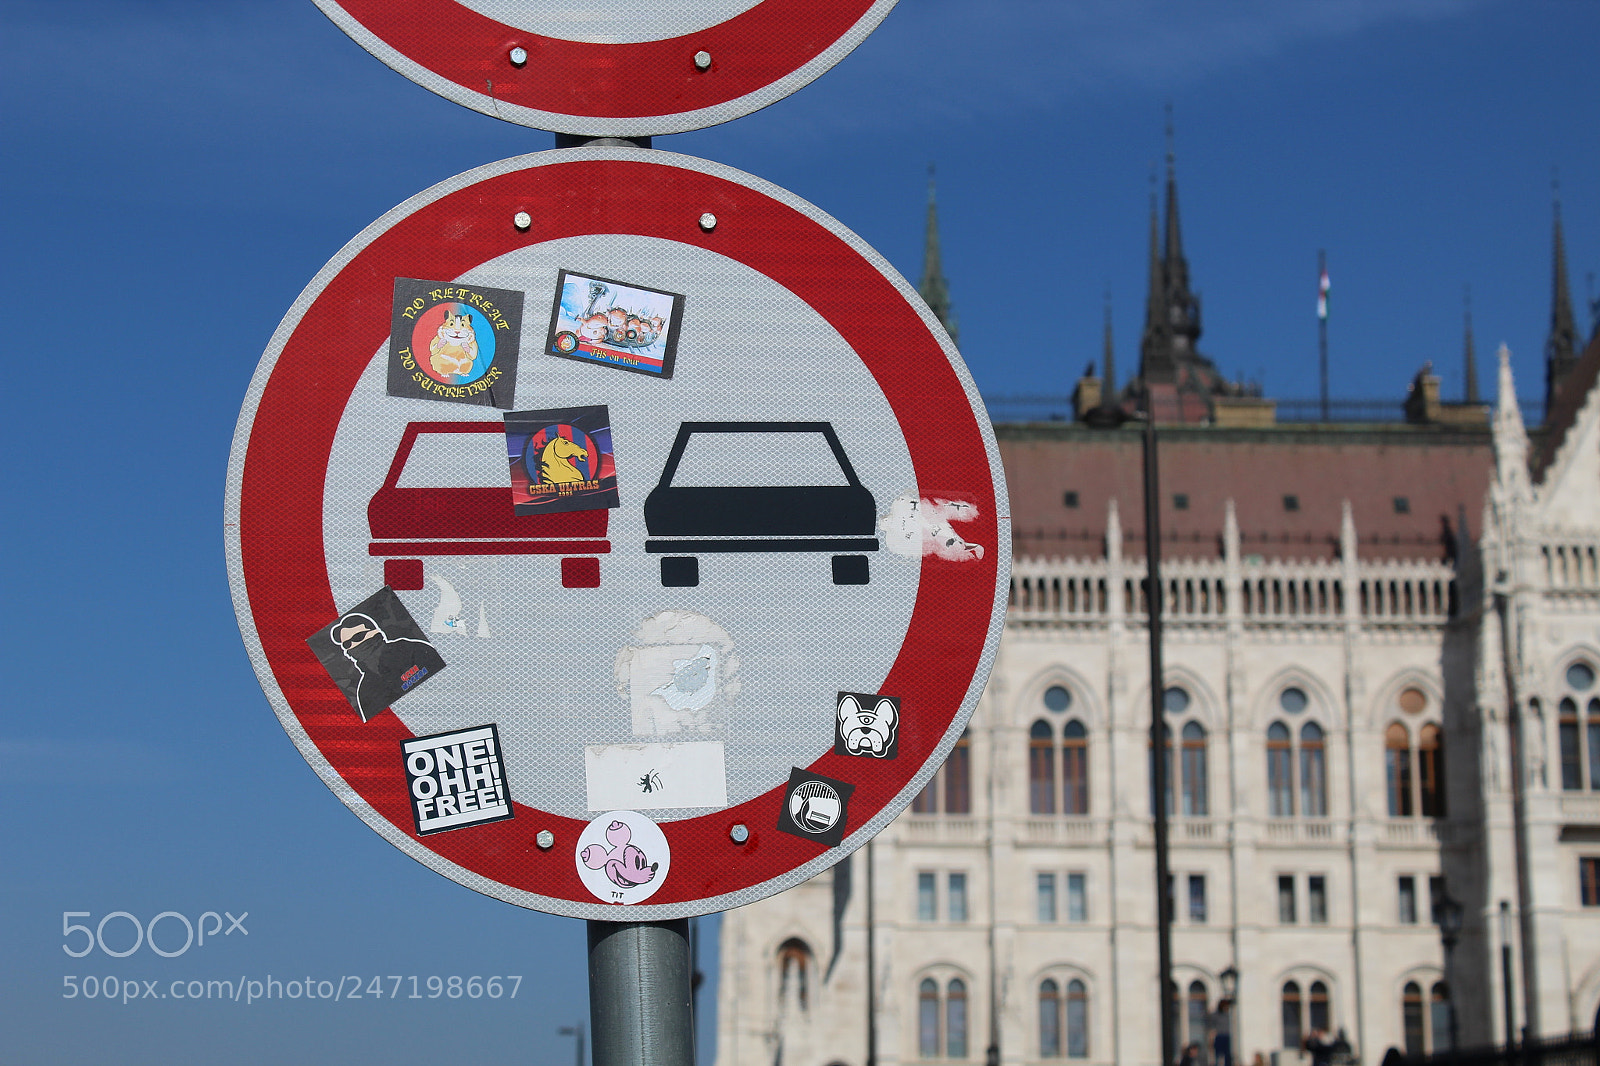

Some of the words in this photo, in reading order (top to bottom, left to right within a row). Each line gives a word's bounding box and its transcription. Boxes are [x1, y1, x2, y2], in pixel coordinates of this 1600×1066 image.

[402, 298, 425, 319] NO
[428, 287, 510, 330] RETREAT
[398, 346, 416, 370] NO
[411, 366, 503, 398] SURRENDER
[529, 484, 557, 495] CSKA
[558, 479, 600, 493] ULTRAS
[407, 738, 498, 777] ONE!
[412, 762, 503, 800] OHH!
[416, 785, 506, 820] FREE!
